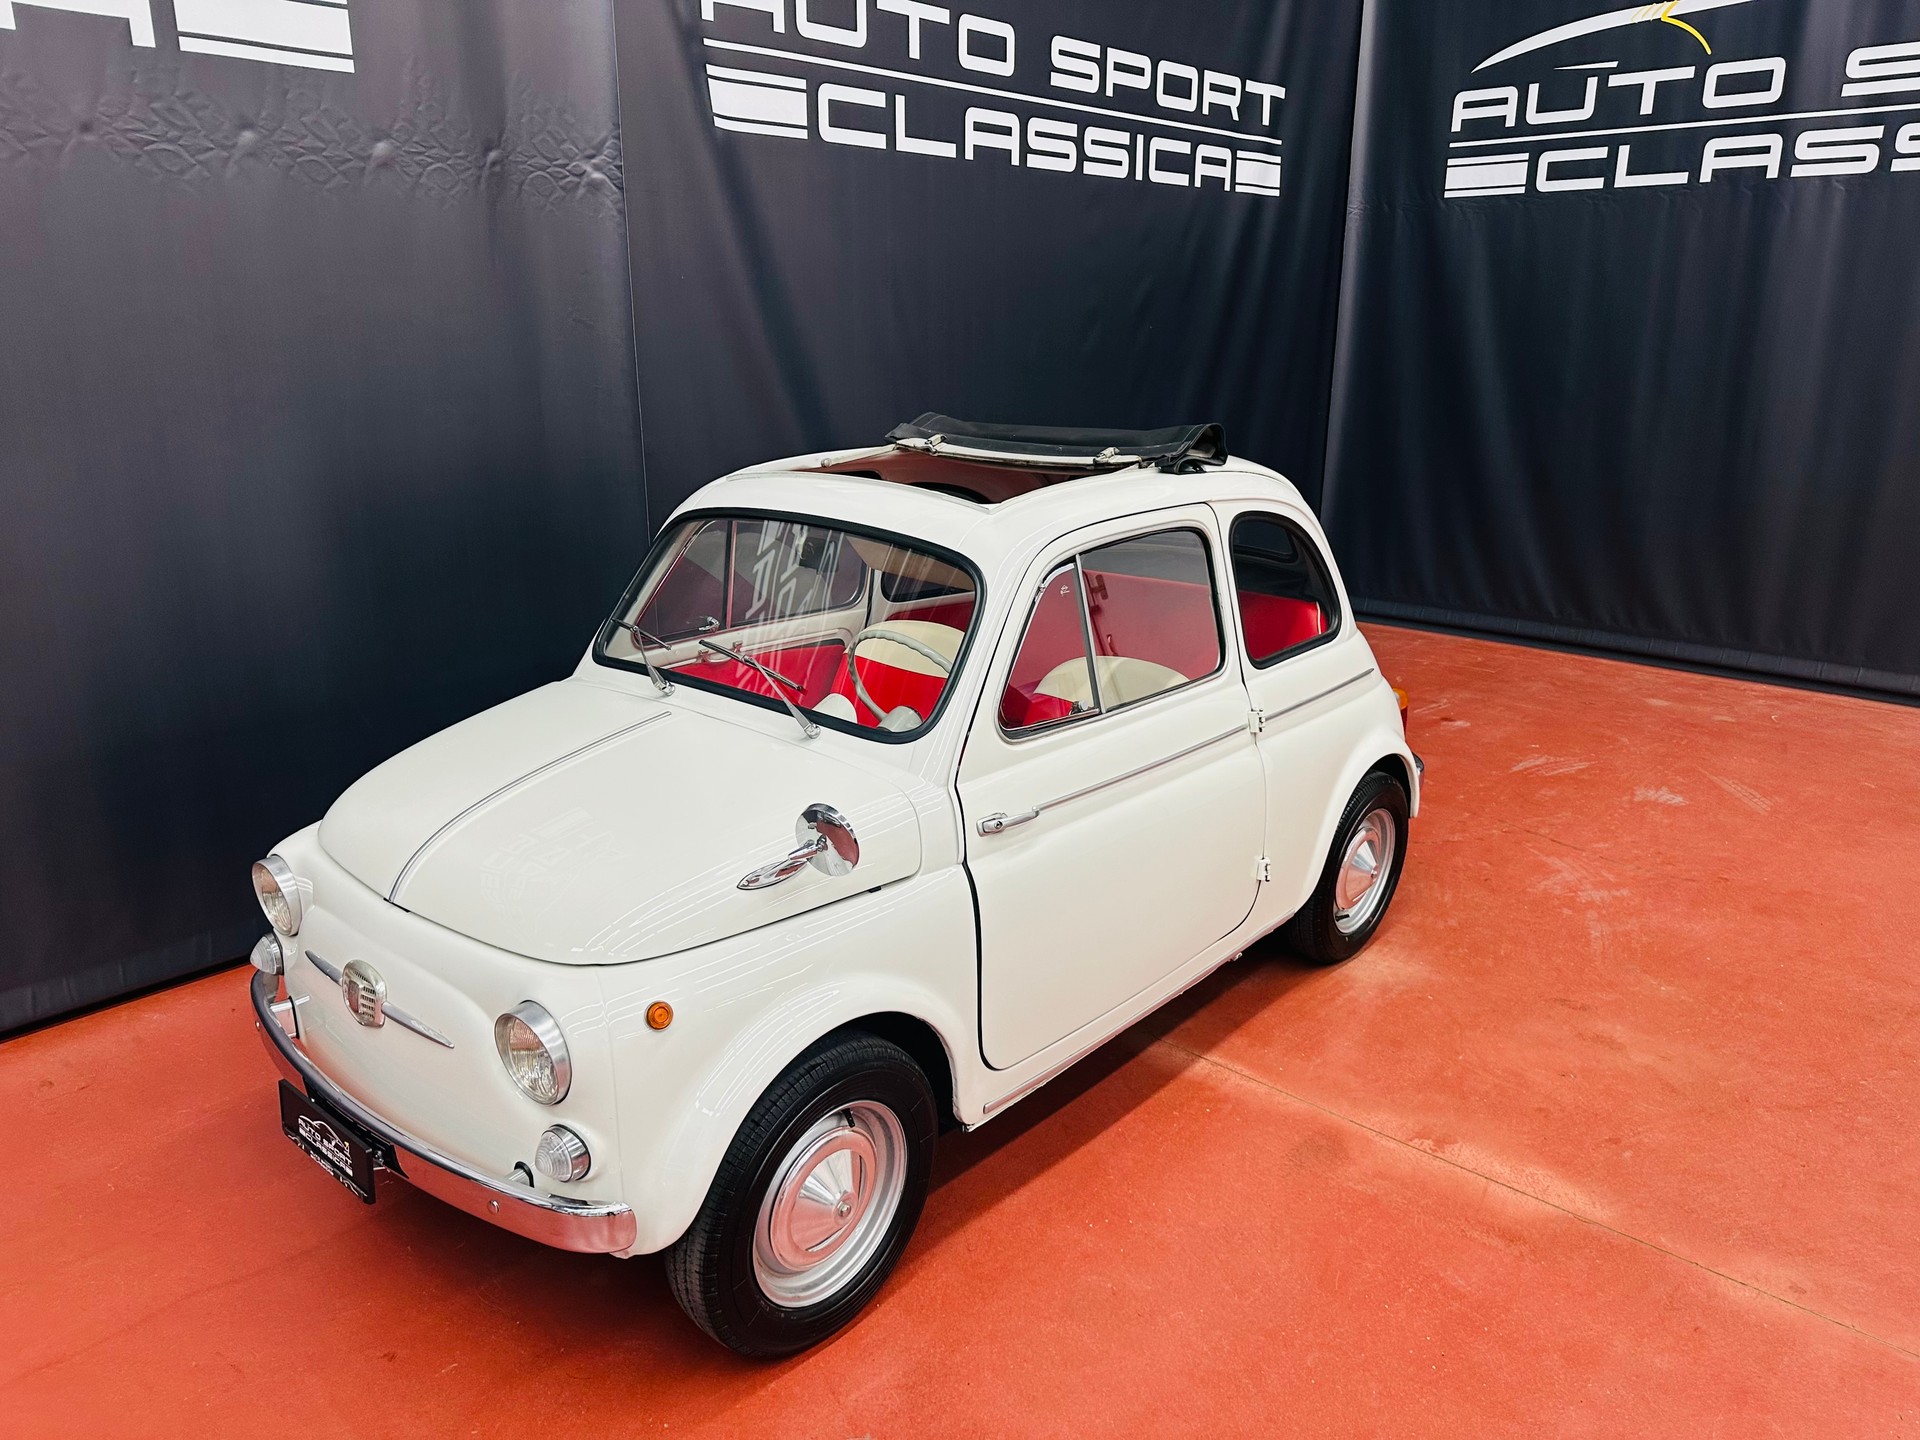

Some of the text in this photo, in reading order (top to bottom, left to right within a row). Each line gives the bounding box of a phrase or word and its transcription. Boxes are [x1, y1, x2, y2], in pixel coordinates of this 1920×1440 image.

[1050, 35, 1286, 126] SPORT
[1451, 57, 1787, 133] AUTO
[817, 83, 1232, 192] CLASSICA
[298, 1117, 322, 1141] AUTO
